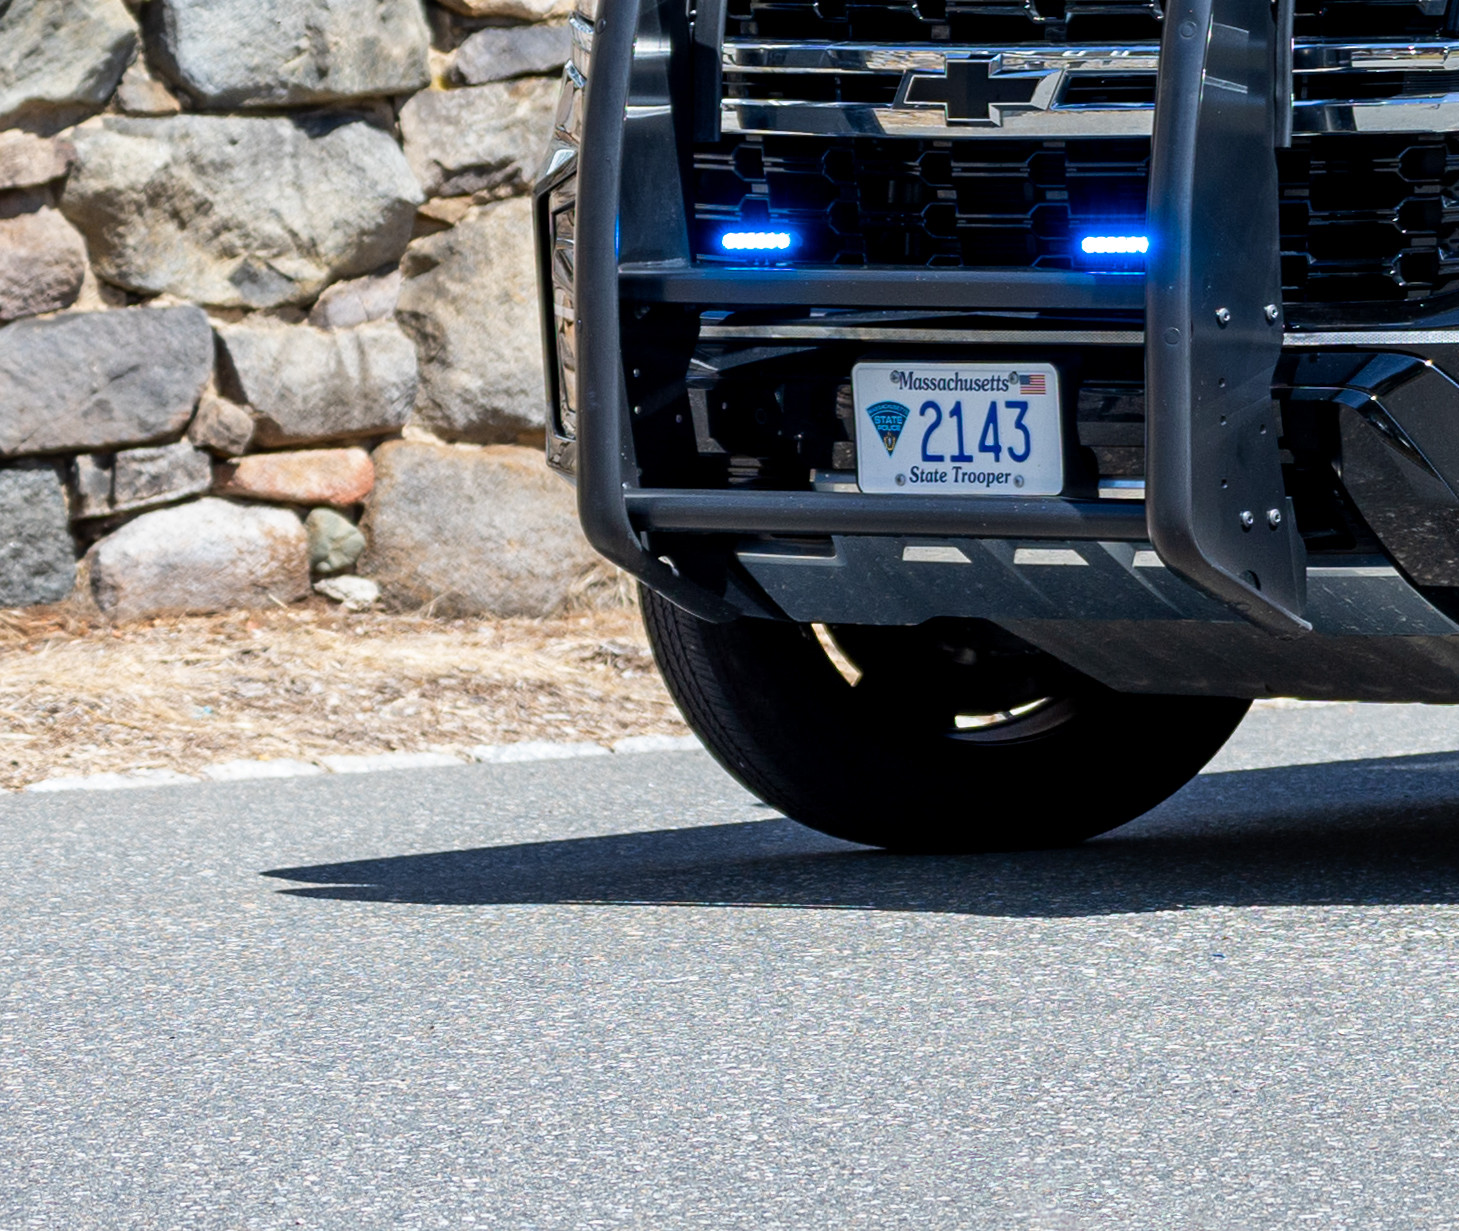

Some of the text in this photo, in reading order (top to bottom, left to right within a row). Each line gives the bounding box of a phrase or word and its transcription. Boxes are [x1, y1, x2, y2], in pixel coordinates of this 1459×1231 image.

[899, 371, 1009, 392] Massachusetts
[919, 400, 1031, 463] 2143
[909, 466, 1012, 488] State Trooper
